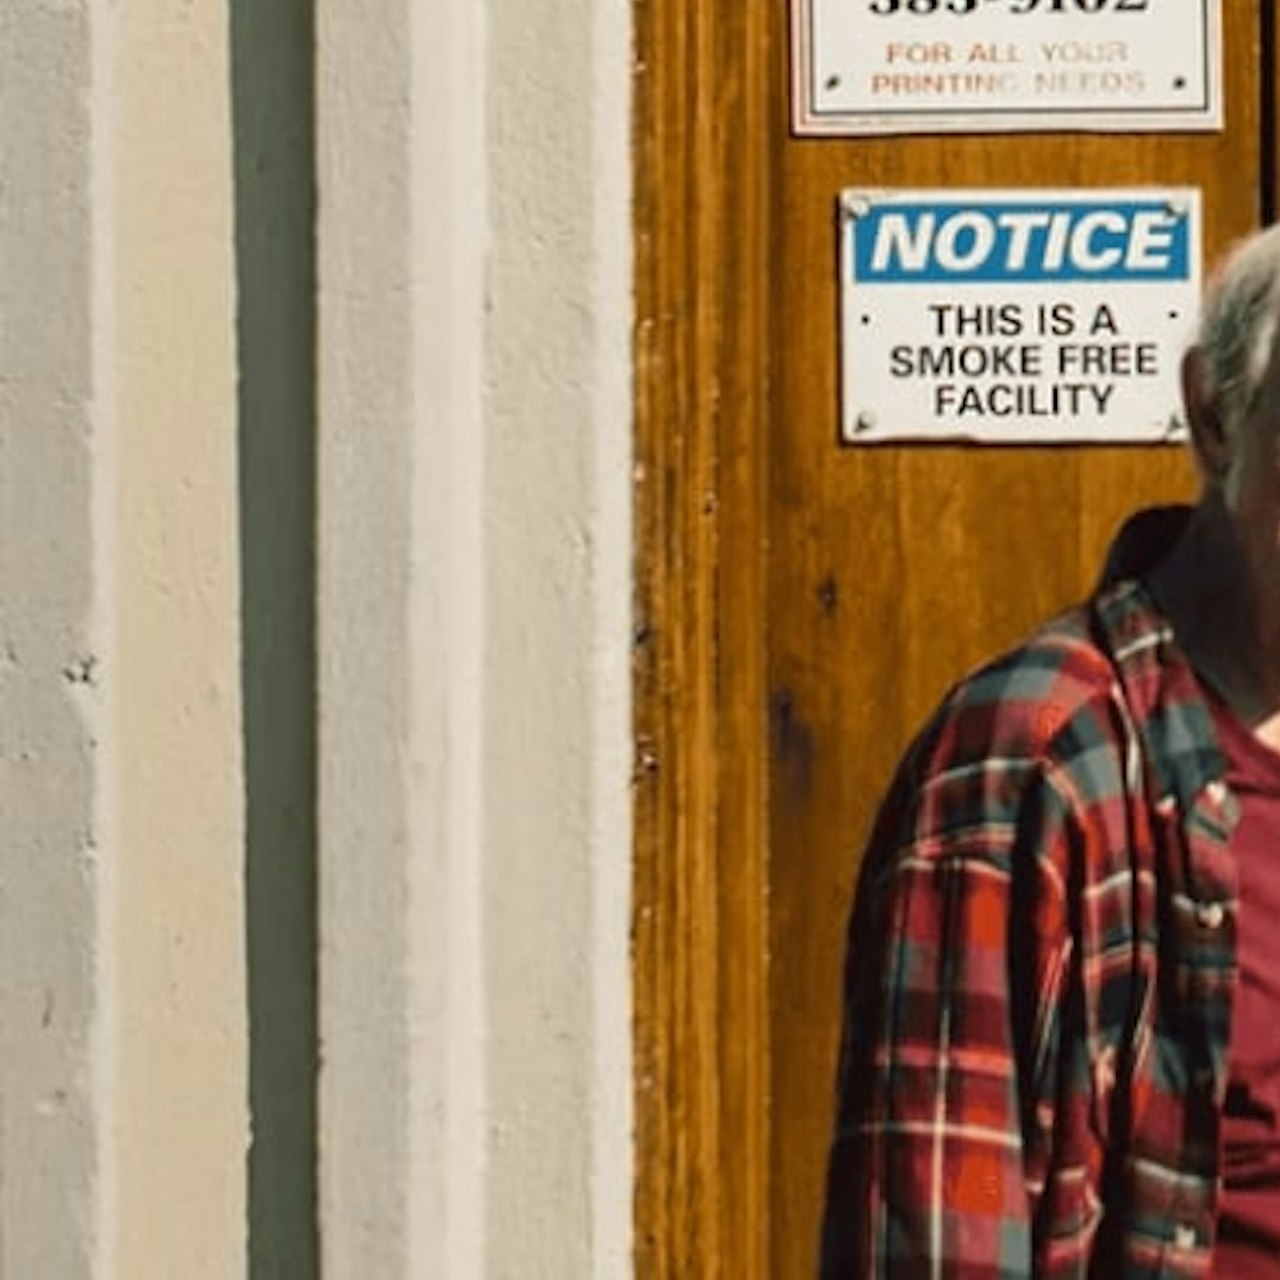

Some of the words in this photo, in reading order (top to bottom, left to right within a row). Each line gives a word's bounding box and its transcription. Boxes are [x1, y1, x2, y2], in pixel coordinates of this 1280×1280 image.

[886, 42, 952, 63] FOR
[968, 42, 1022, 62] ALL
[1041, 41, 1129, 61] YOUR
[870, 210, 1178, 272] NOTICE
[929, 304, 1022, 336] THIS
[1038, 304, 1076, 335] IS
[1090, 304, 1118, 335] A
[890, 346, 1041, 377] SMOKE
[1058, 345, 1158, 375] FREE
[935, 384, 1115, 416] FACILITY
